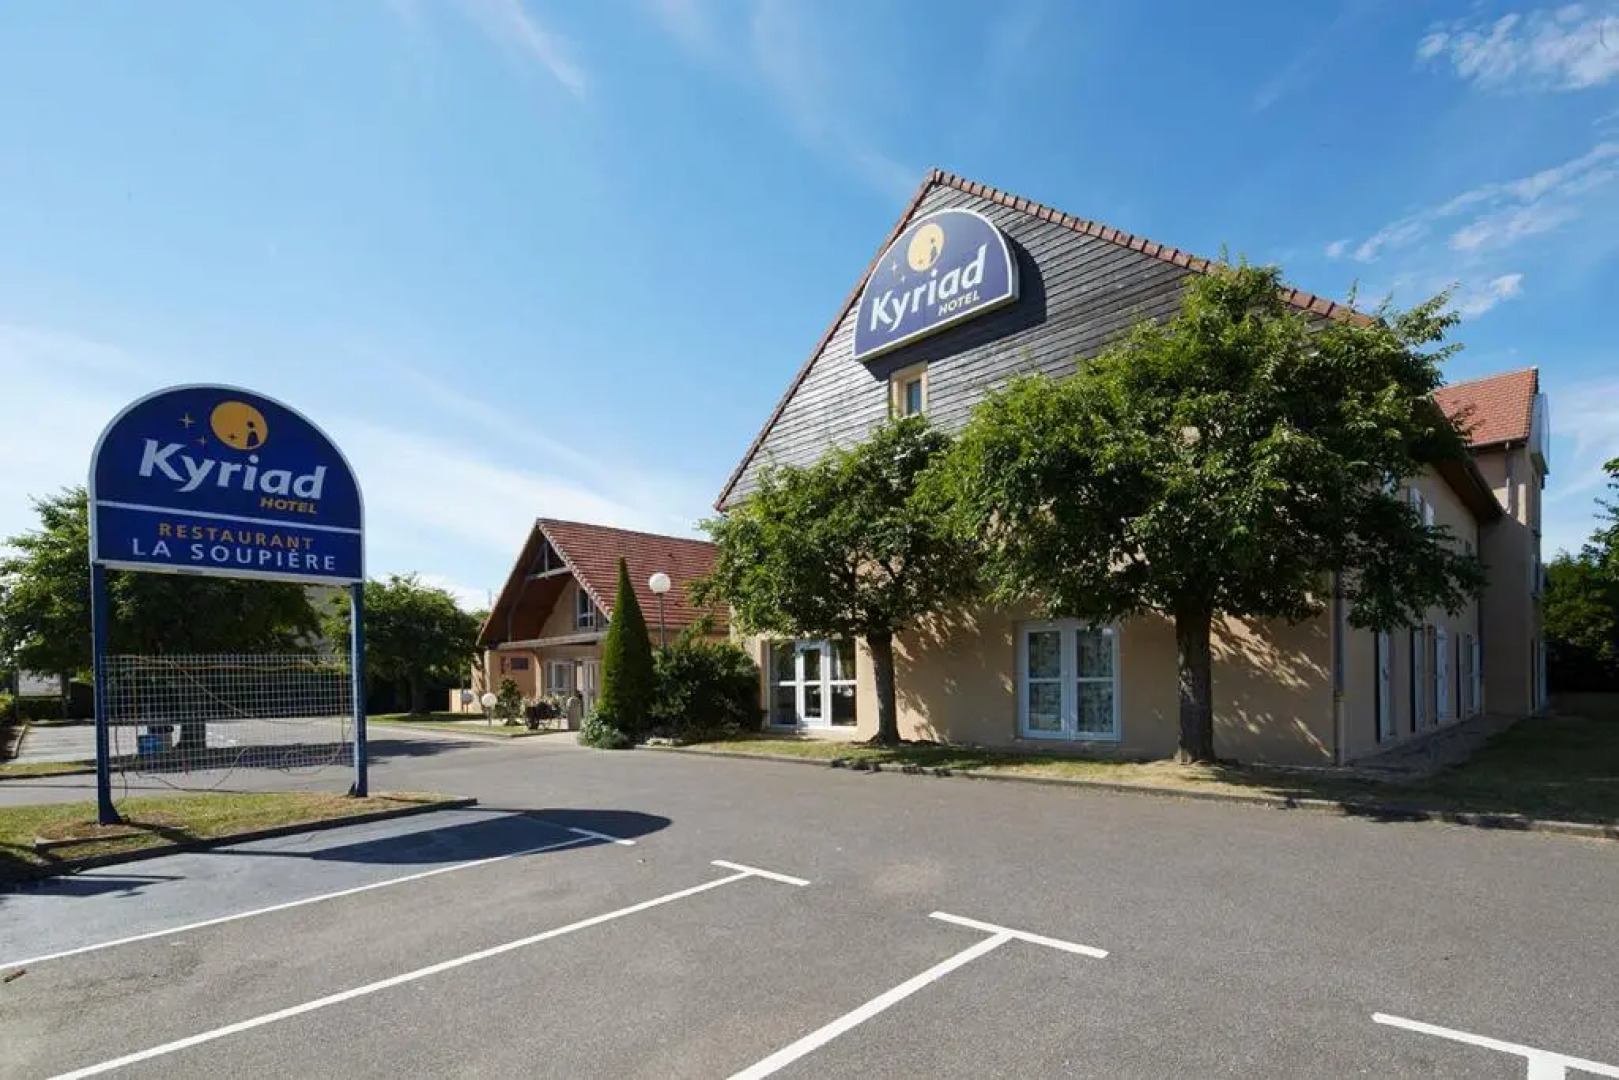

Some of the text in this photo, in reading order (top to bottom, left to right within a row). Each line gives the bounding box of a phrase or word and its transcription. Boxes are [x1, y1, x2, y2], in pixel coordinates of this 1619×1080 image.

[870, 243, 988, 333] Kyriad
[938, 290, 980, 316] HOTEL
[138, 437, 328, 500] Kyriad
[259, 497, 318, 514] HOTEL
[159, 522, 314, 549] RESTAURANT
[132, 538, 336, 571] LA SOUPIÈRE
